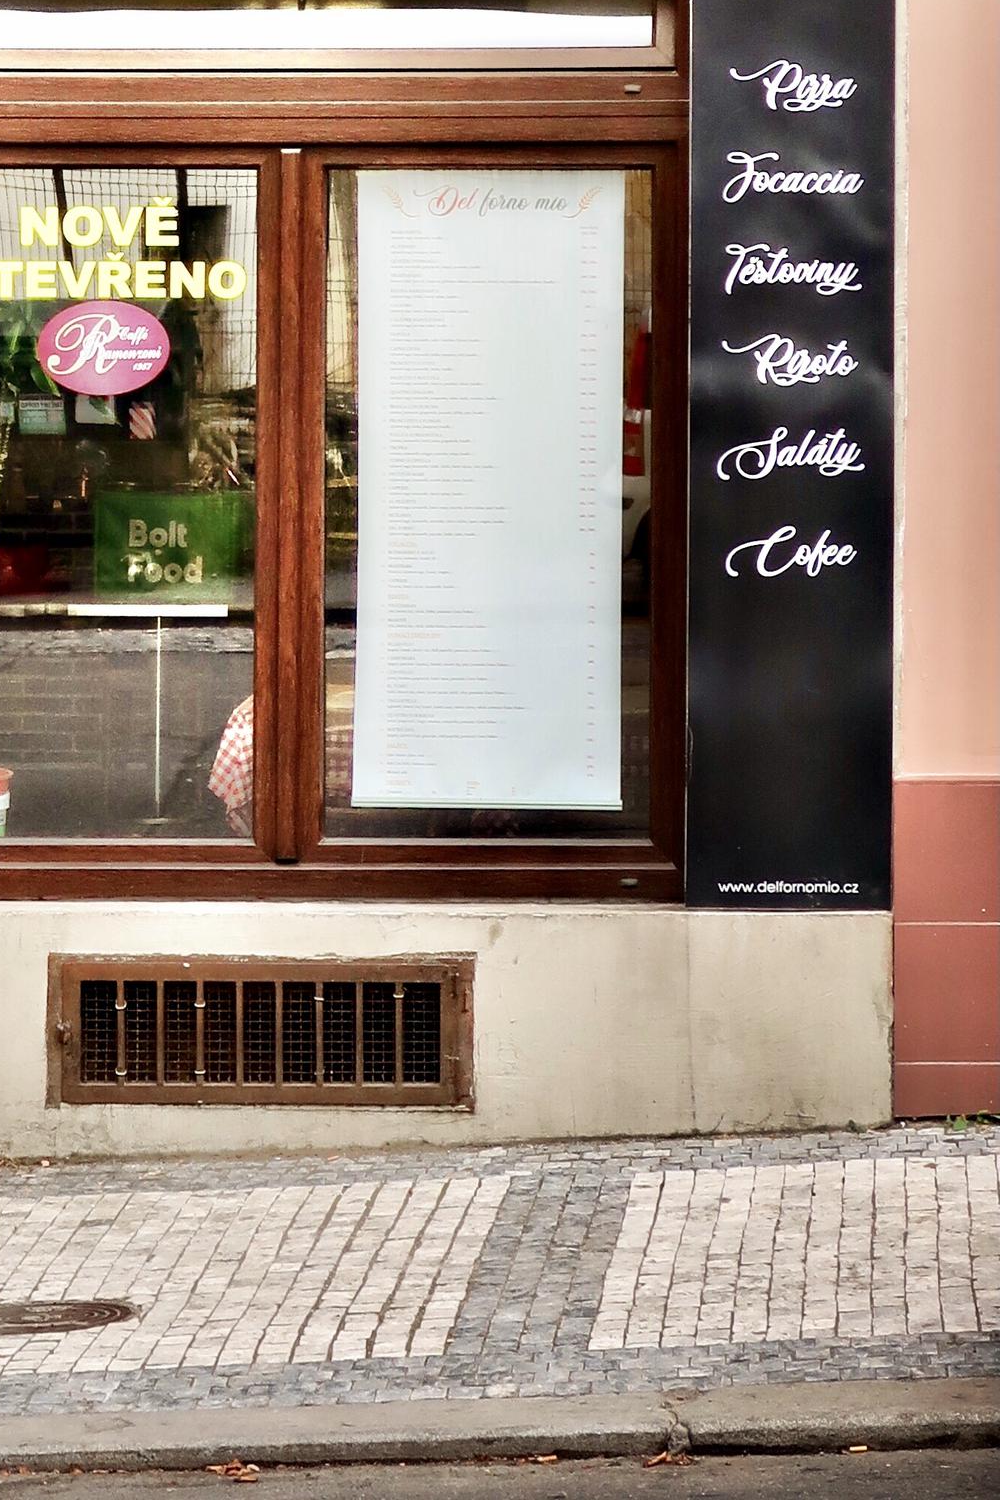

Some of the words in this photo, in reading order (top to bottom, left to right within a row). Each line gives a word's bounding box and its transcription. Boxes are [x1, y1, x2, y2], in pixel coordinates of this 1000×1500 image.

[729, 59, 858, 112] Pizza
[413, 184, 479, 217] Del
[479, 187, 531, 217] forno
[534, 194, 569, 211] mio
[722, 151, 865, 204] Focaccia
[19, 196, 180, 247] NOVĚ
[721, 333, 858, 387] Rizoto
[716, 426, 865, 479] Saláty
[129, 519, 187, 548] Bolt
[725, 525, 857, 577] Cofee
[128, 552, 203, 583] Food
[718, 880, 859, 894] www.delfornomio.cz
